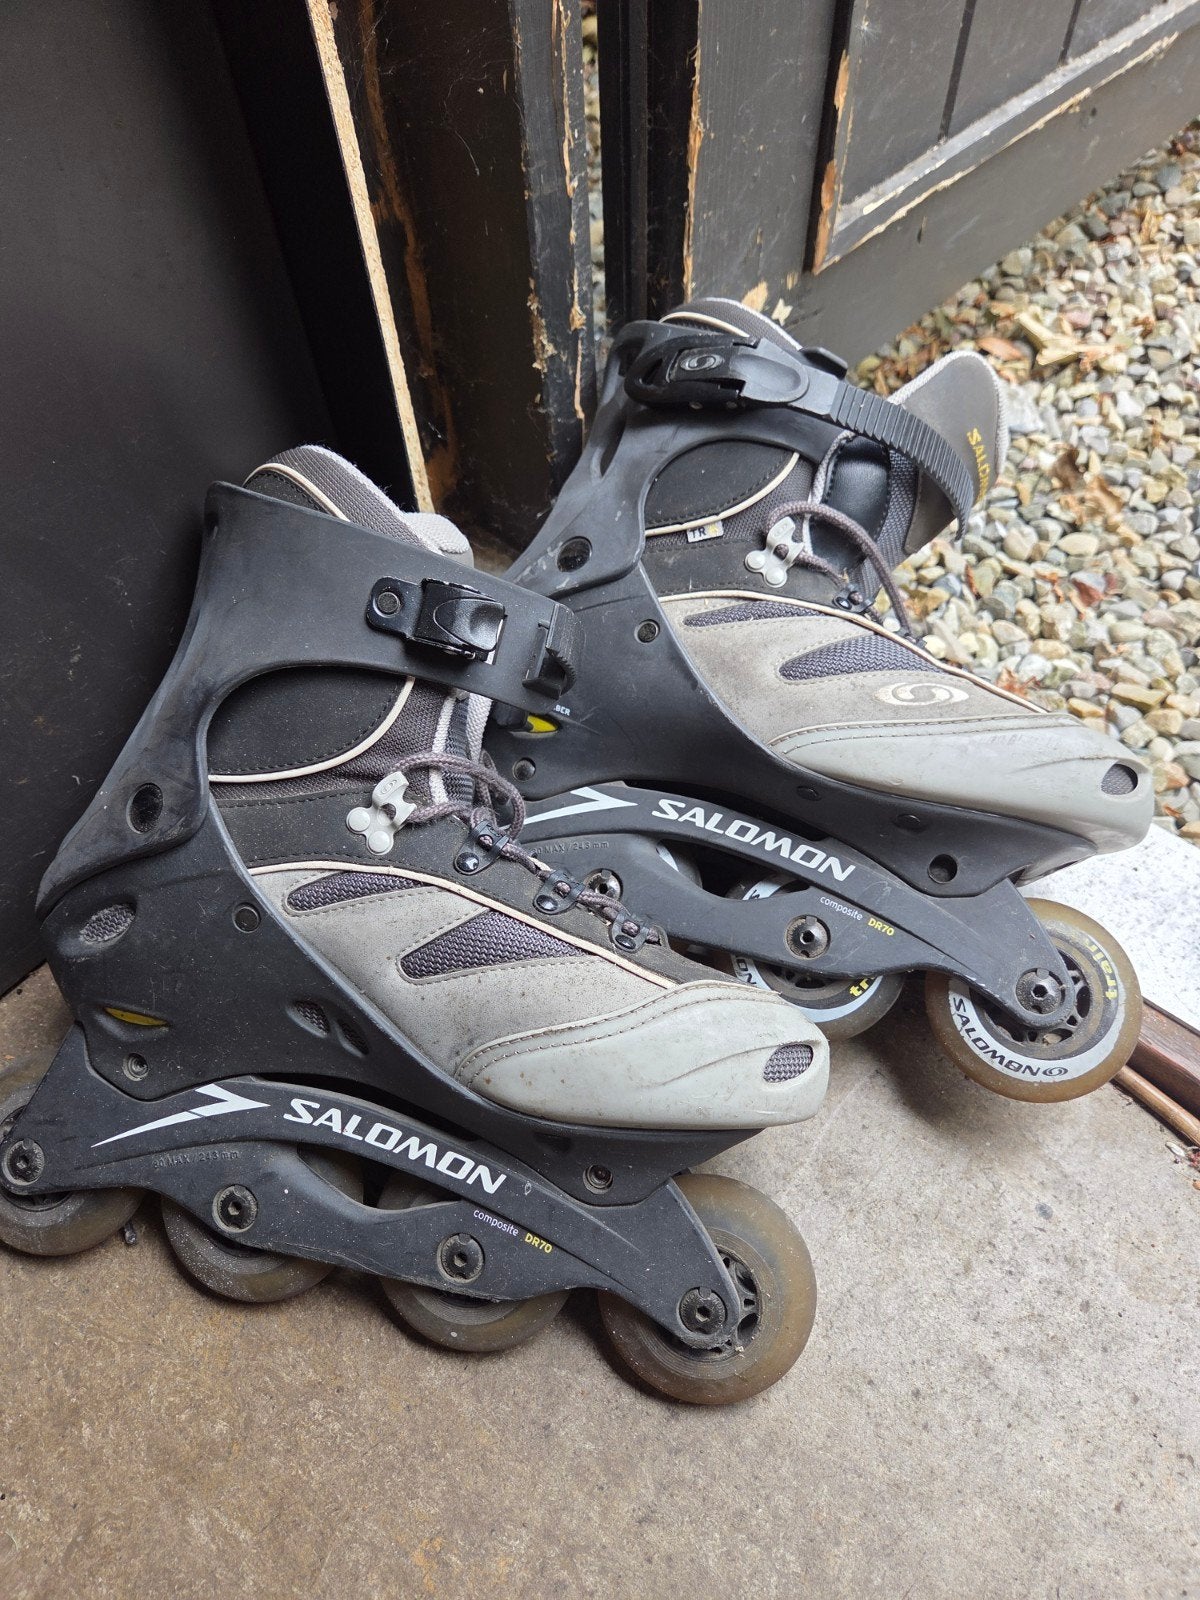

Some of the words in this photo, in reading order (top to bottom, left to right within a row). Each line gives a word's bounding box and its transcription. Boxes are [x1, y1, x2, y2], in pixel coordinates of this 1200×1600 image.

[966, 427, 991, 502] SALO
[652, 798, 857, 882] SALOMON
[820, 896, 864, 921] composite
[868, 917, 895, 936] DR70
[953, 997, 1041, 1077] SALOMON
[283, 1098, 507, 1195] SALOMON
[473, 1209, 519, 1237] composite
[524, 1232, 553, 1254] DR70
